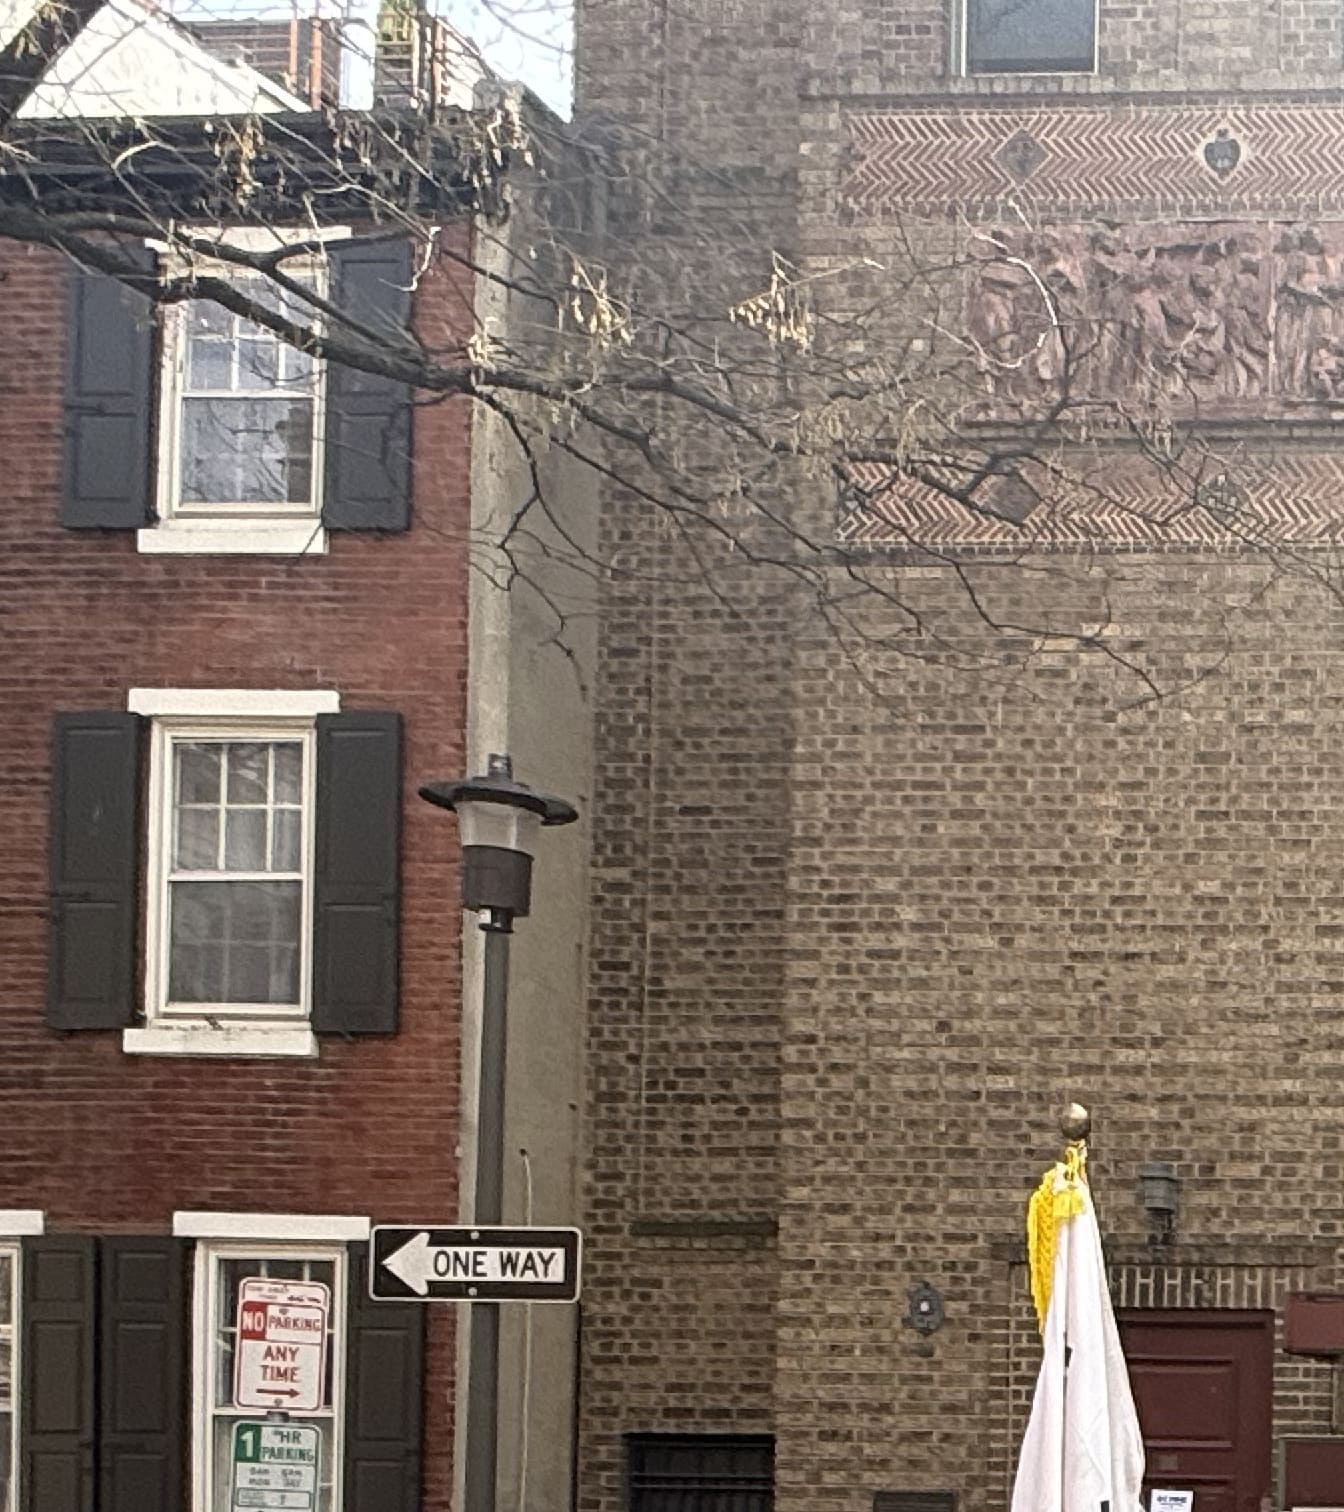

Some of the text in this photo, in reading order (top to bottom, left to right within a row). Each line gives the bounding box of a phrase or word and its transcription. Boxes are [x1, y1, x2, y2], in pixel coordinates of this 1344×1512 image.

[433, 1250, 557, 1278] ONE WAY
[241, 1310, 321, 1332] NO PARKING
[263, 1345, 300, 1361] ANY
[260, 1364, 300, 1382] TIME
[240, 1430, 302, 1458] 1 HR
[261, 1446, 315, 1461] PARKING
